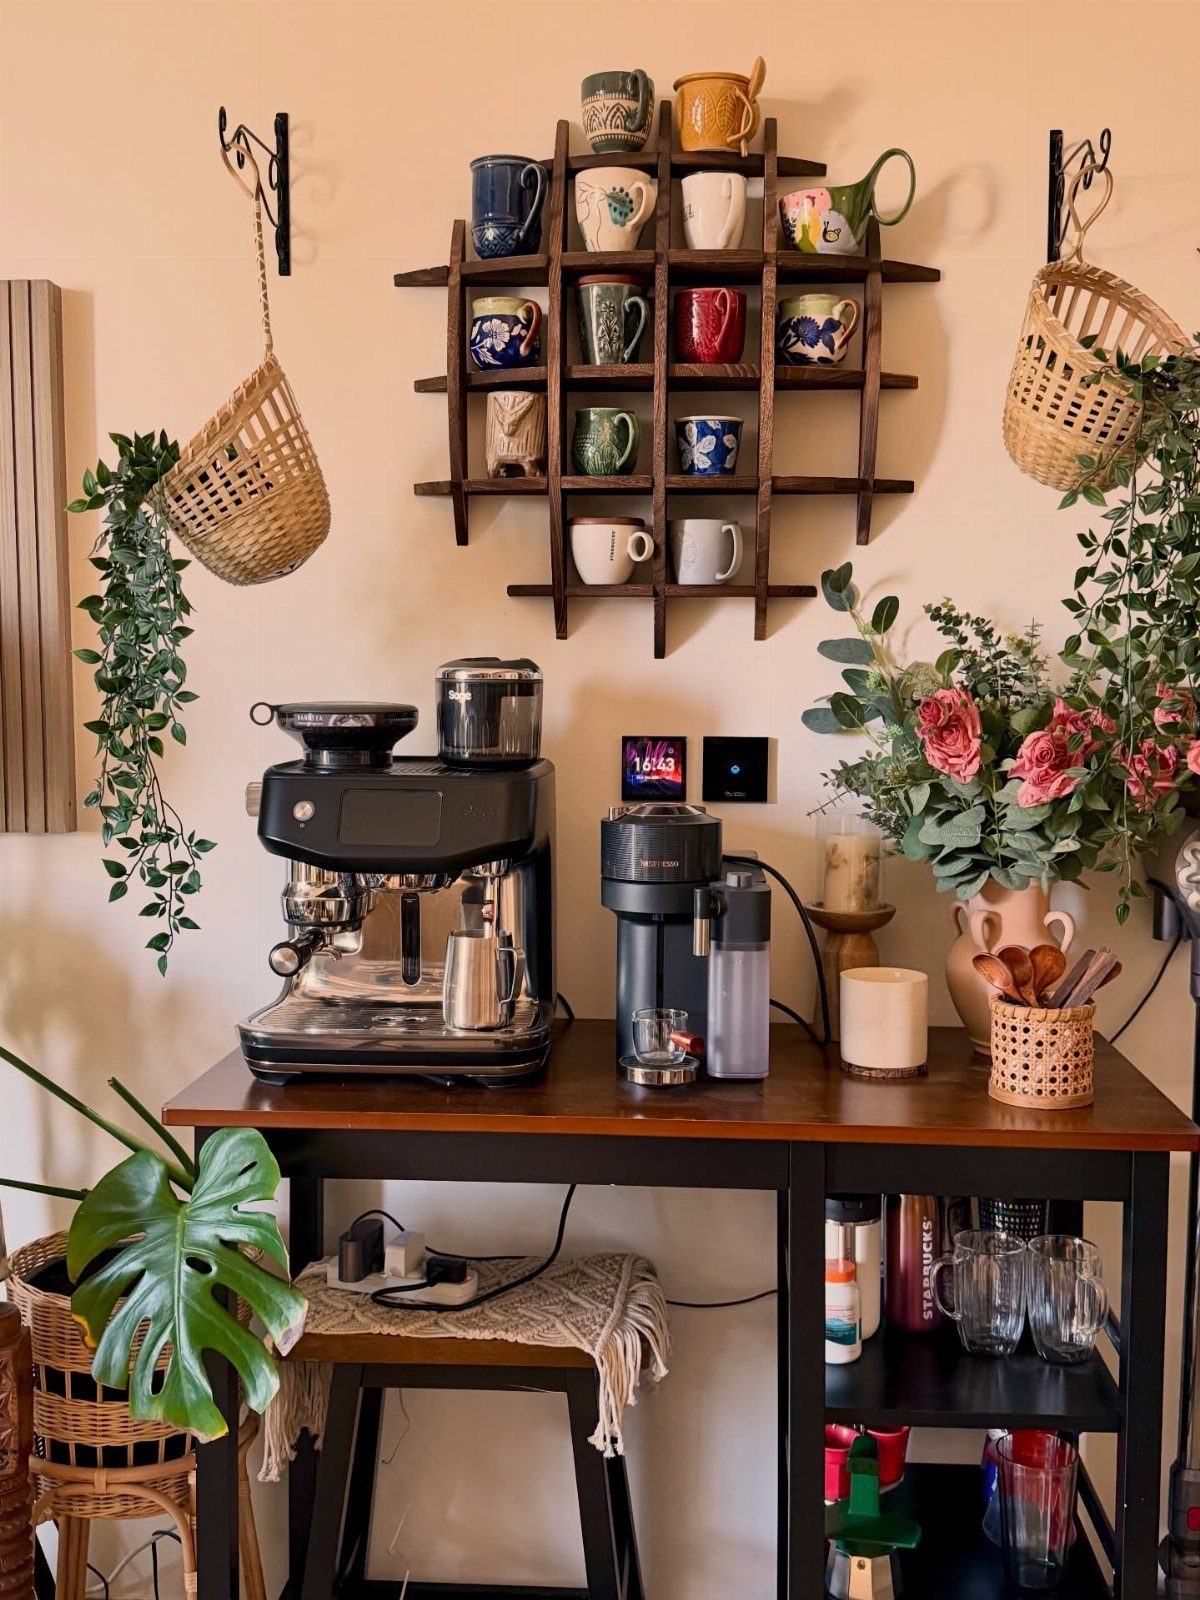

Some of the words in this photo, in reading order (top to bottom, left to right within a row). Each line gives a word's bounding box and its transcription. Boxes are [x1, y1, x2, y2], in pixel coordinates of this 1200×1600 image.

[448, 689, 472, 704] Sage
[634, 756, 675, 772] 16:43
[922, 1219, 933, 1320] STARBUCKS
